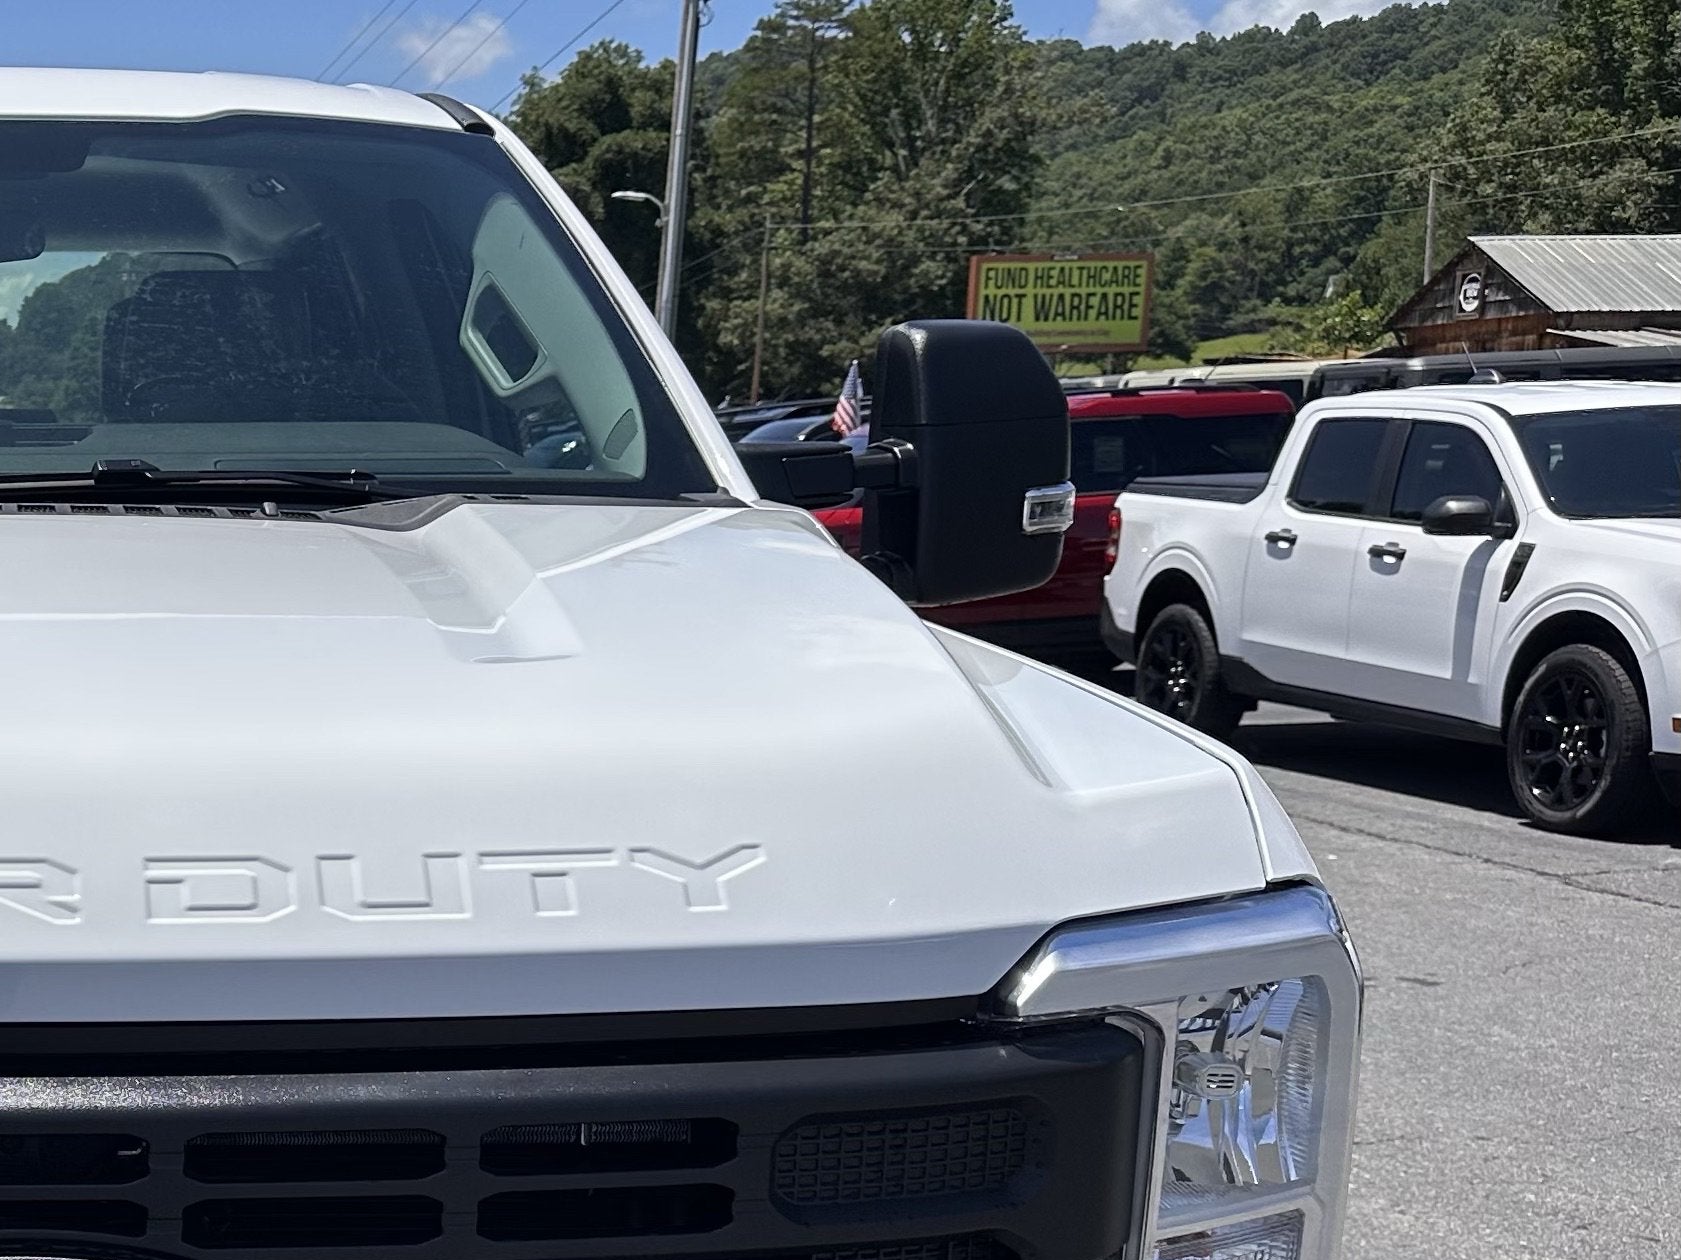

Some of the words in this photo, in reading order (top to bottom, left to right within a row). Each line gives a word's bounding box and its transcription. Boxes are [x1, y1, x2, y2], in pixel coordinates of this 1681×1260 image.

[984, 266, 1029, 289] FUND
[1033, 265, 1143, 288] HEALTHCARE
[982, 293, 1027, 322] NOT
[1033, 291, 1141, 322] WARFARE
[142, 843, 768, 924] DUTY
